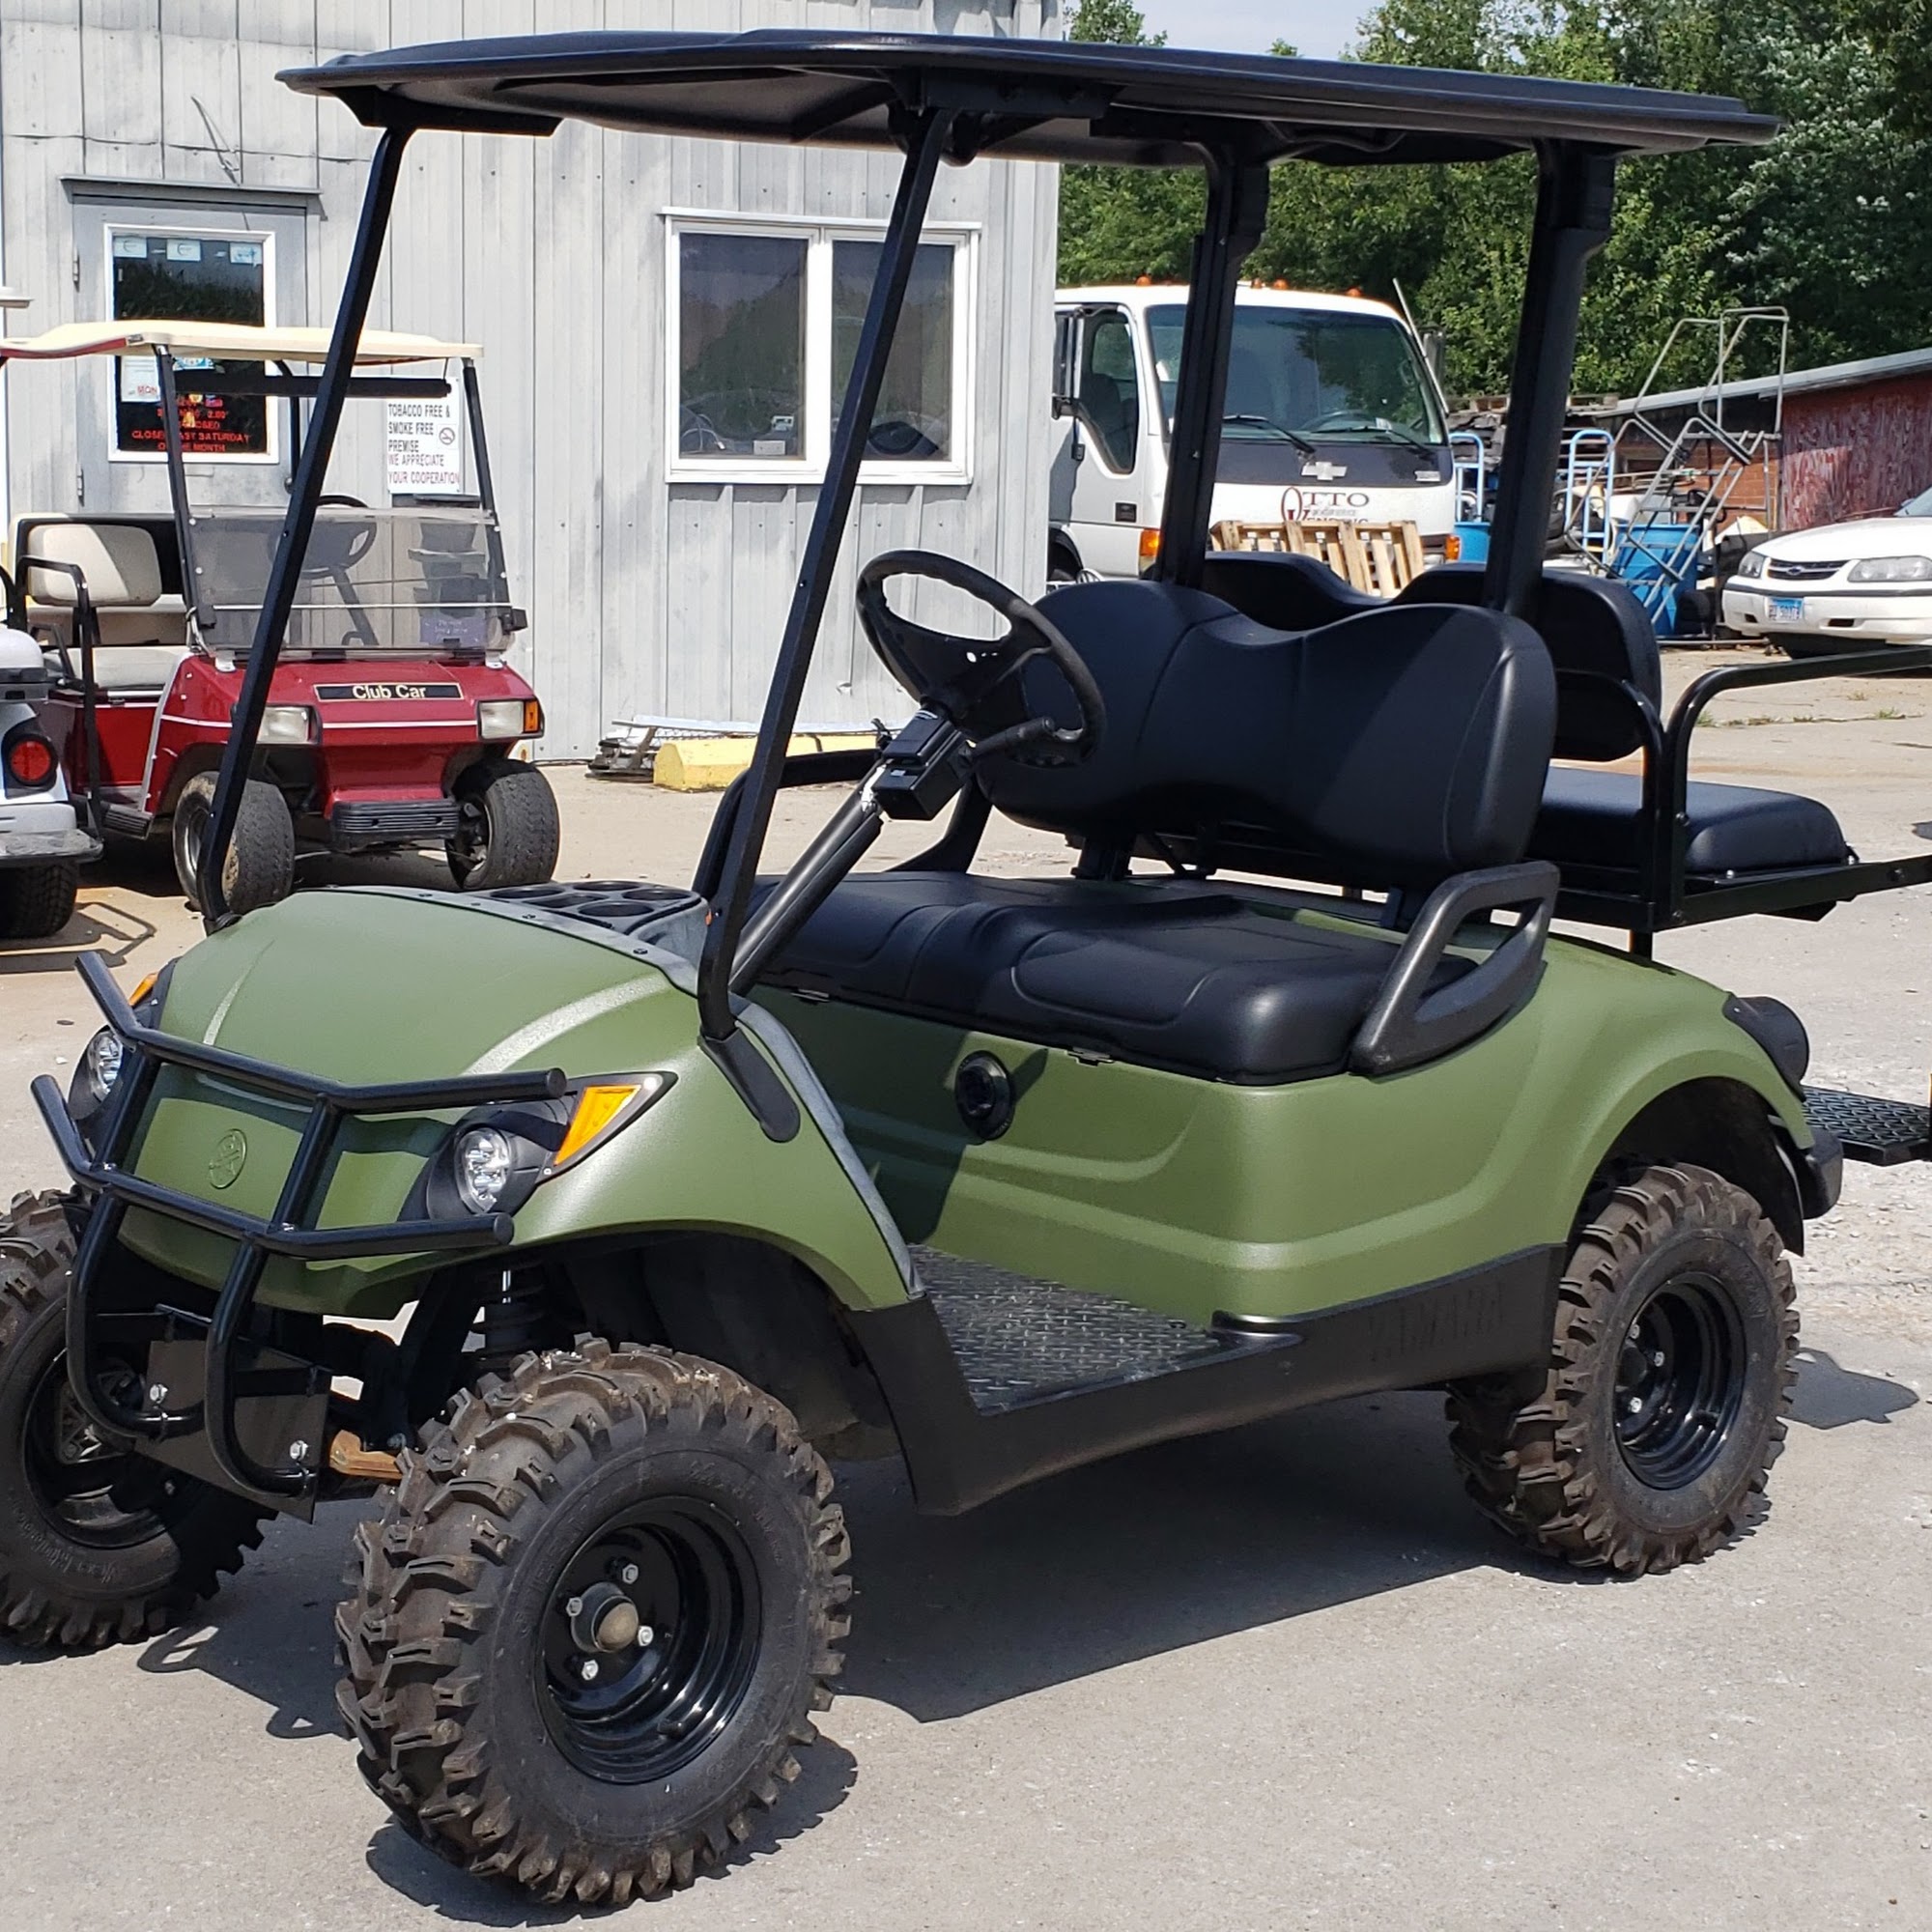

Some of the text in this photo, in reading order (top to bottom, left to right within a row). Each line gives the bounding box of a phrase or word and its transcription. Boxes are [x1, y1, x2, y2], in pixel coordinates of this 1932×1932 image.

[388, 404, 422, 417] TOBACCO
[425, 404, 442, 417] FREE
[388, 422, 434, 436] SMOKE FREE
[131, 430, 164, 440] CLOSE
[198, 432, 250, 443] SATURDAY
[192, 443, 225, 452] MONTH
[388, 454, 444, 467] WE APPRECIATE
[388, 471, 461, 484] YOUR COOPERATION
[1281, 486, 1370, 522] OTTO
[353, 684, 427, 699] Club Car
